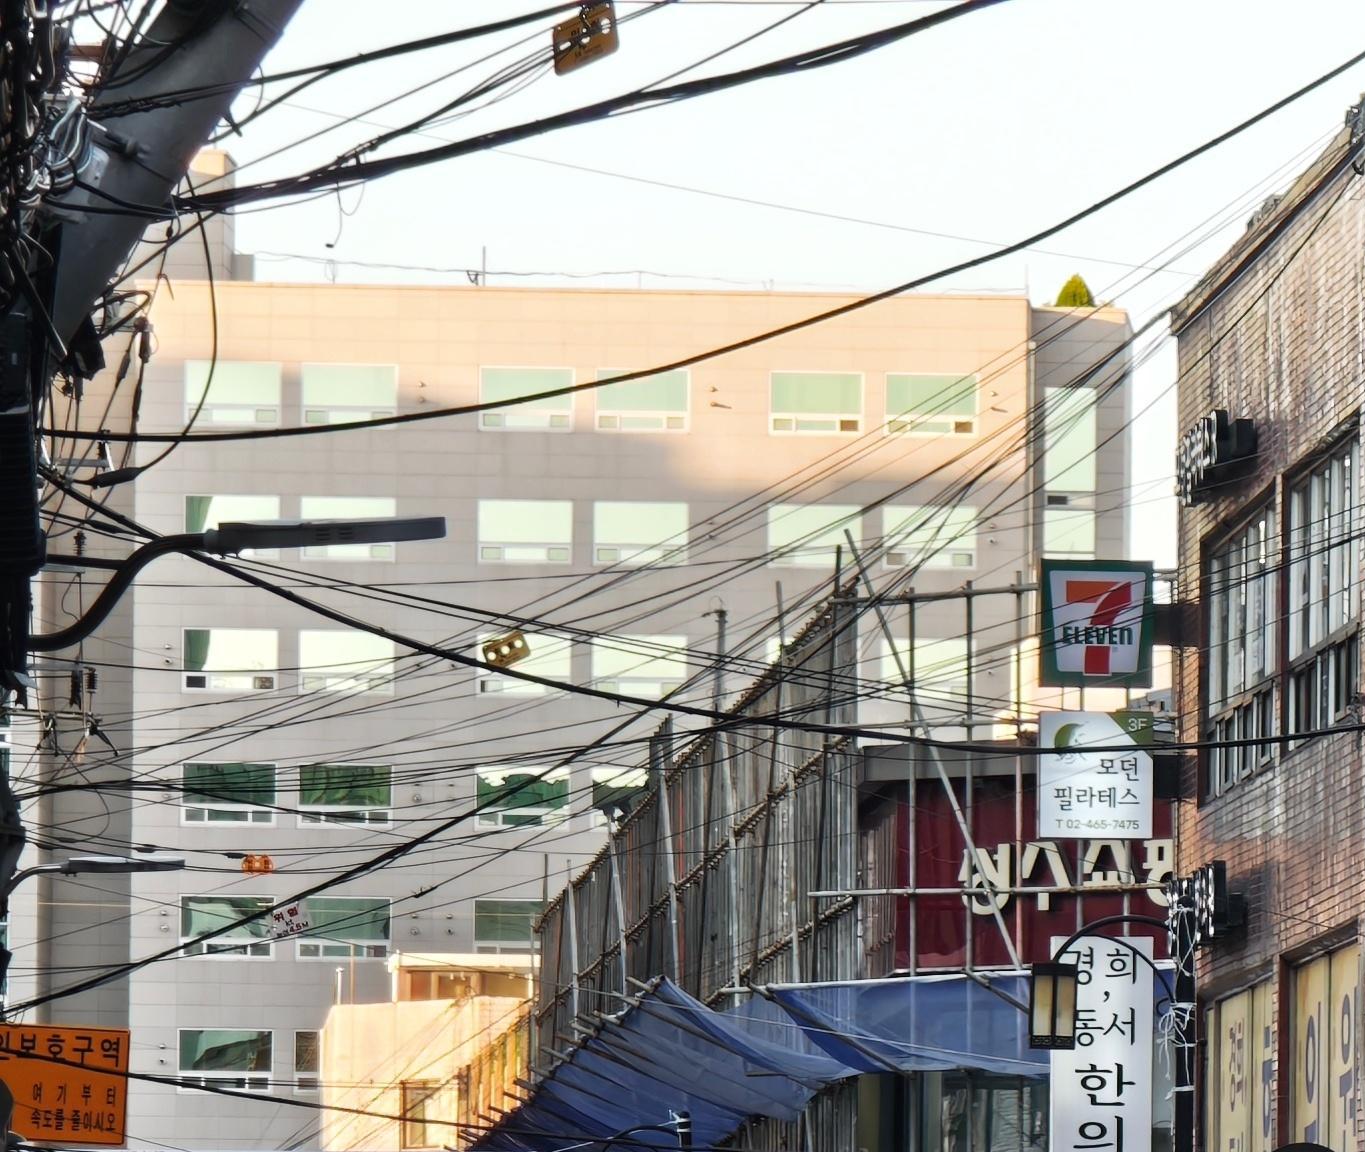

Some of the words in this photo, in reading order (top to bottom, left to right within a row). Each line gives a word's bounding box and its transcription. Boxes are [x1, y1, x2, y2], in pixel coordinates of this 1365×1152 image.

[1128, 718, 1147, 731] 3F
[1097, 757, 1138, 782] 모던
[1054, 786, 1140, 811] 필라테스
